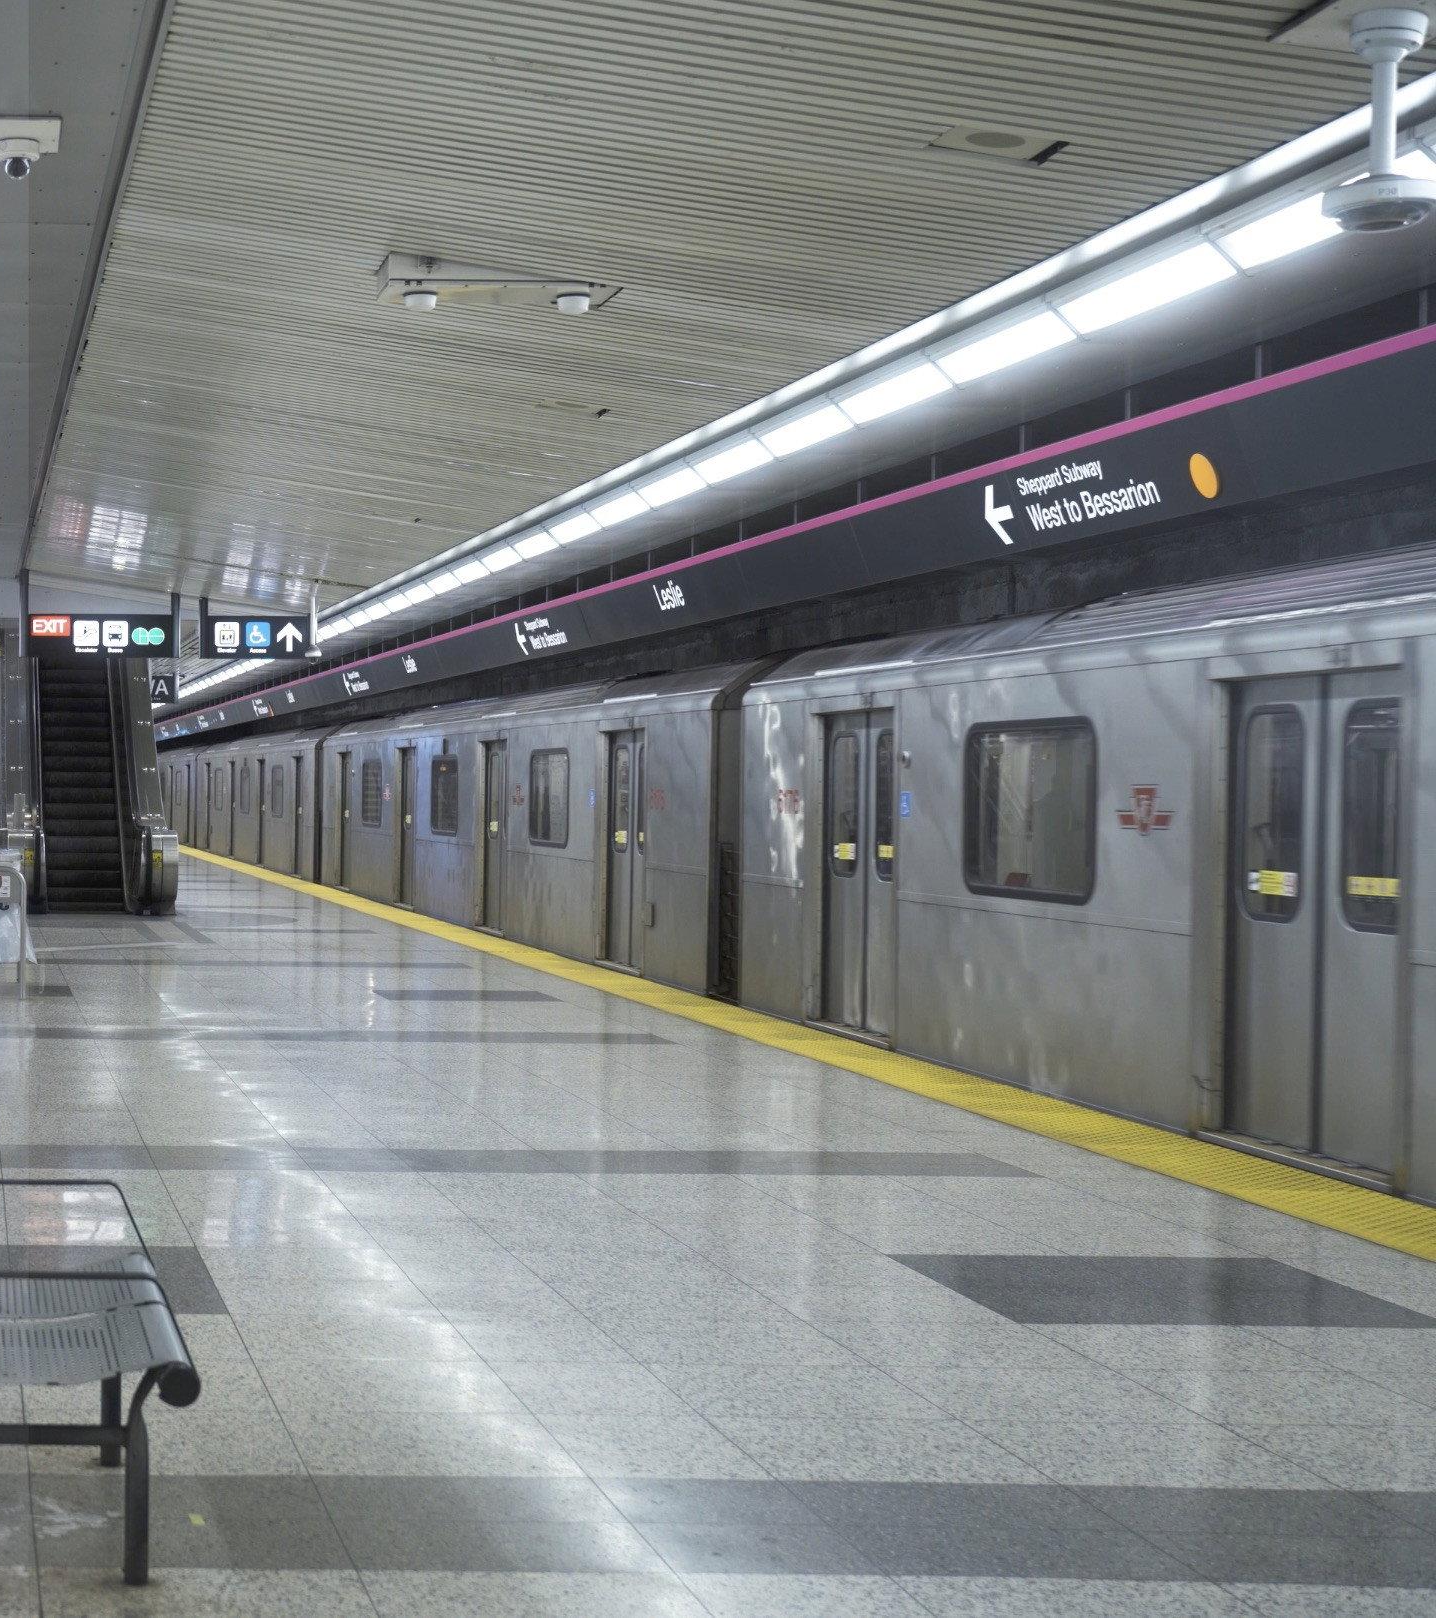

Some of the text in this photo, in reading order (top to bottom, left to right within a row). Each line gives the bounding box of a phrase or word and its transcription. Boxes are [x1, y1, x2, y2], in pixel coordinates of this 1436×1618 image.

[1016, 459, 1103, 496] Sheppard Subway
[1025, 478, 1161, 531] West to Bessarion
[652, 580, 686, 611] Leslie
[32, 618, 68, 634] EXIT
